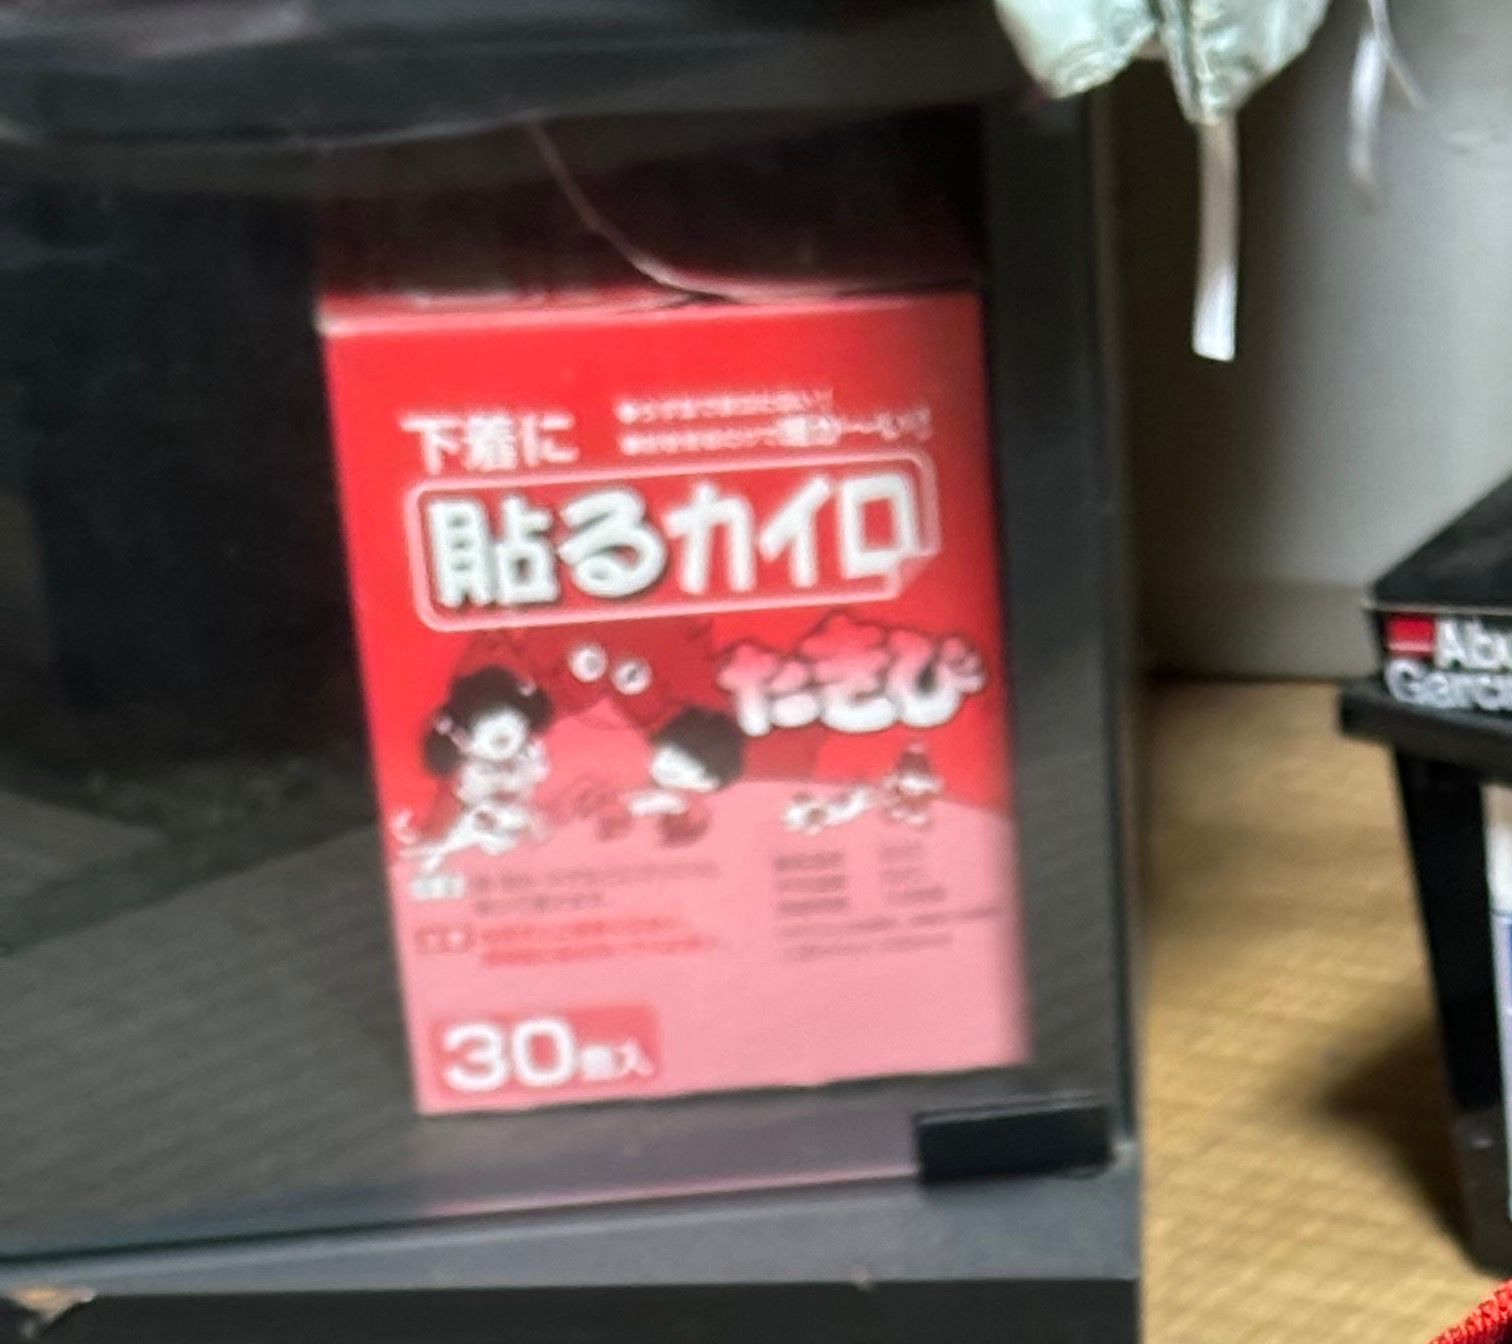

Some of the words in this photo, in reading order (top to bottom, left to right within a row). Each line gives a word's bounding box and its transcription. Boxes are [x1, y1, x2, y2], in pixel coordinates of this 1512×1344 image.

[400, 408, 579, 474] 下着に
[424, 472, 920, 609] 貼るカイロ
